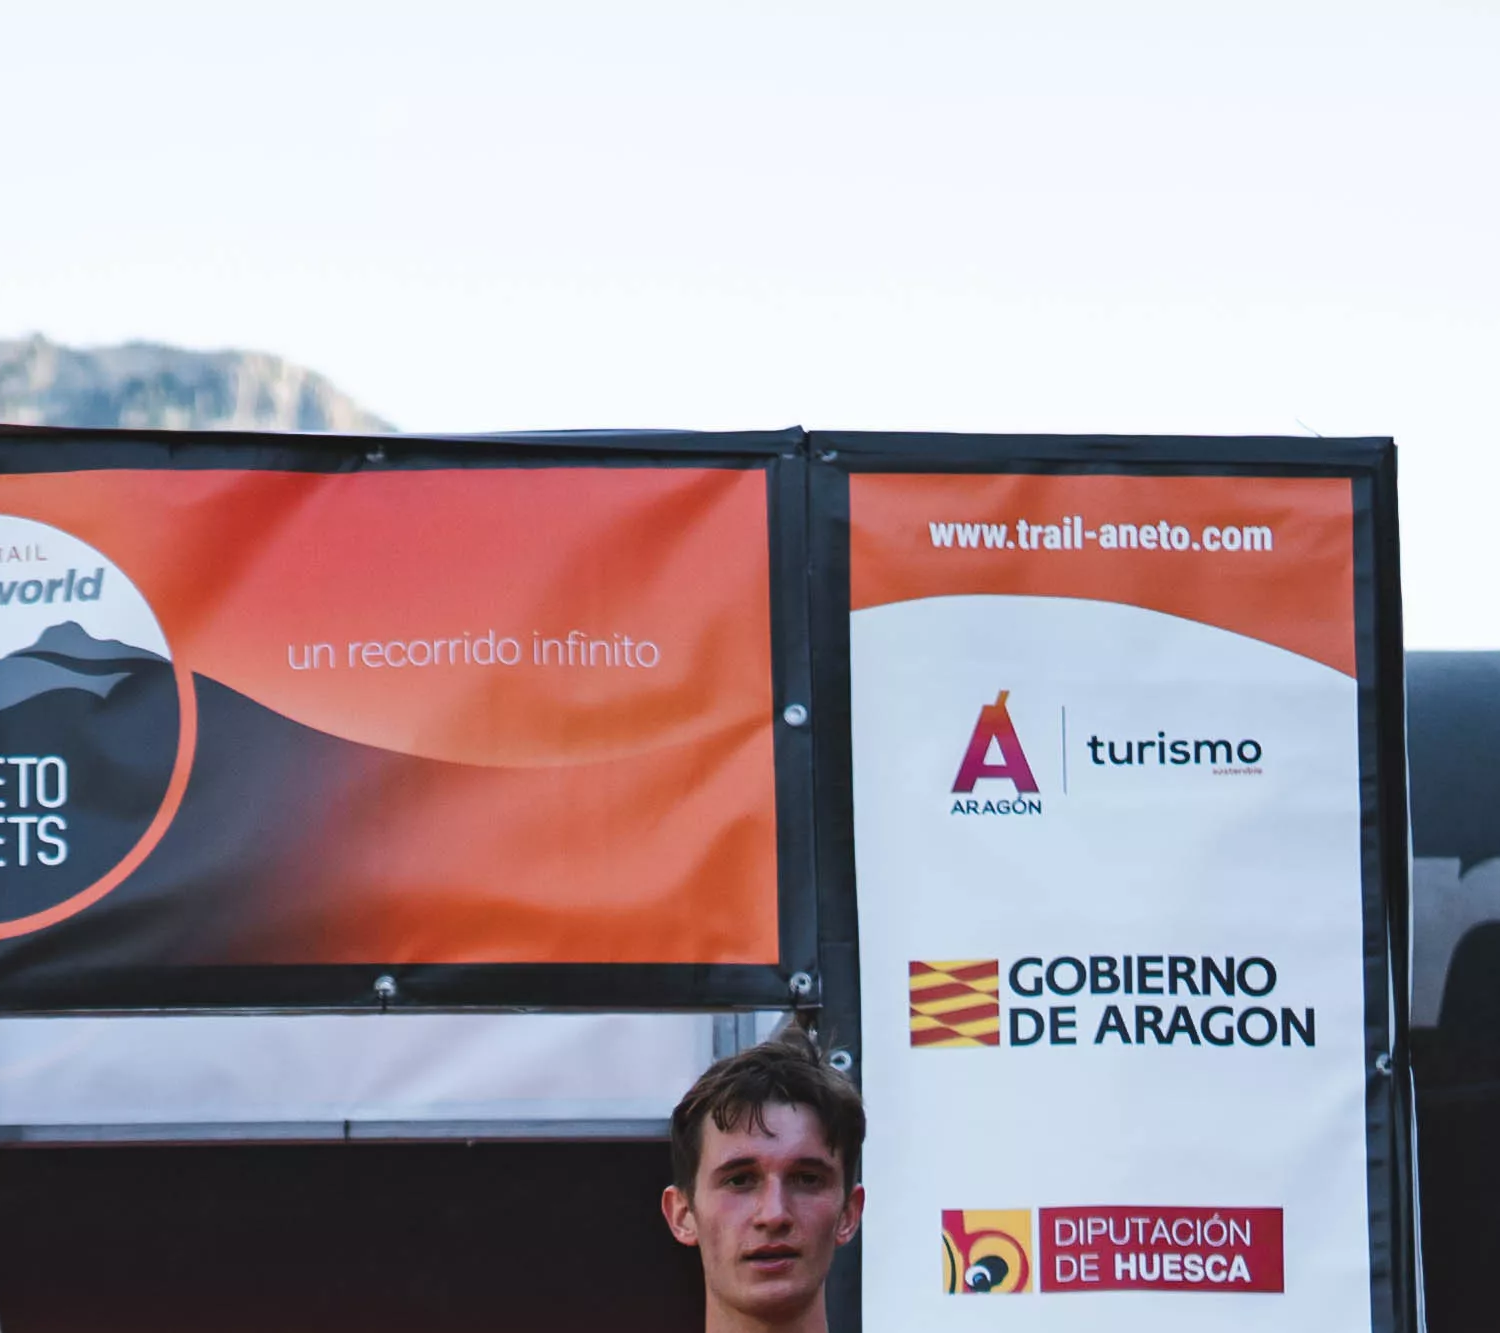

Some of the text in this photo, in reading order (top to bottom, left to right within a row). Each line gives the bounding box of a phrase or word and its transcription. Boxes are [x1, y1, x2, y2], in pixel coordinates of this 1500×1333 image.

[929, 516, 1272, 551] www.trail-aneto.com
[287, 629, 660, 671] un recorrido infinito
[1087, 731, 1263, 766] turismo
[950, 794, 1042, 815] ARAGÓN
[1008, 955, 1277, 997] GOBIERNO
[1008, 1004, 1316, 1047] DE ARAGON
[1054, 1214, 1252, 1249] DIPUTACIÓN
[1054, 1253, 1252, 1283] DE HUESCA
